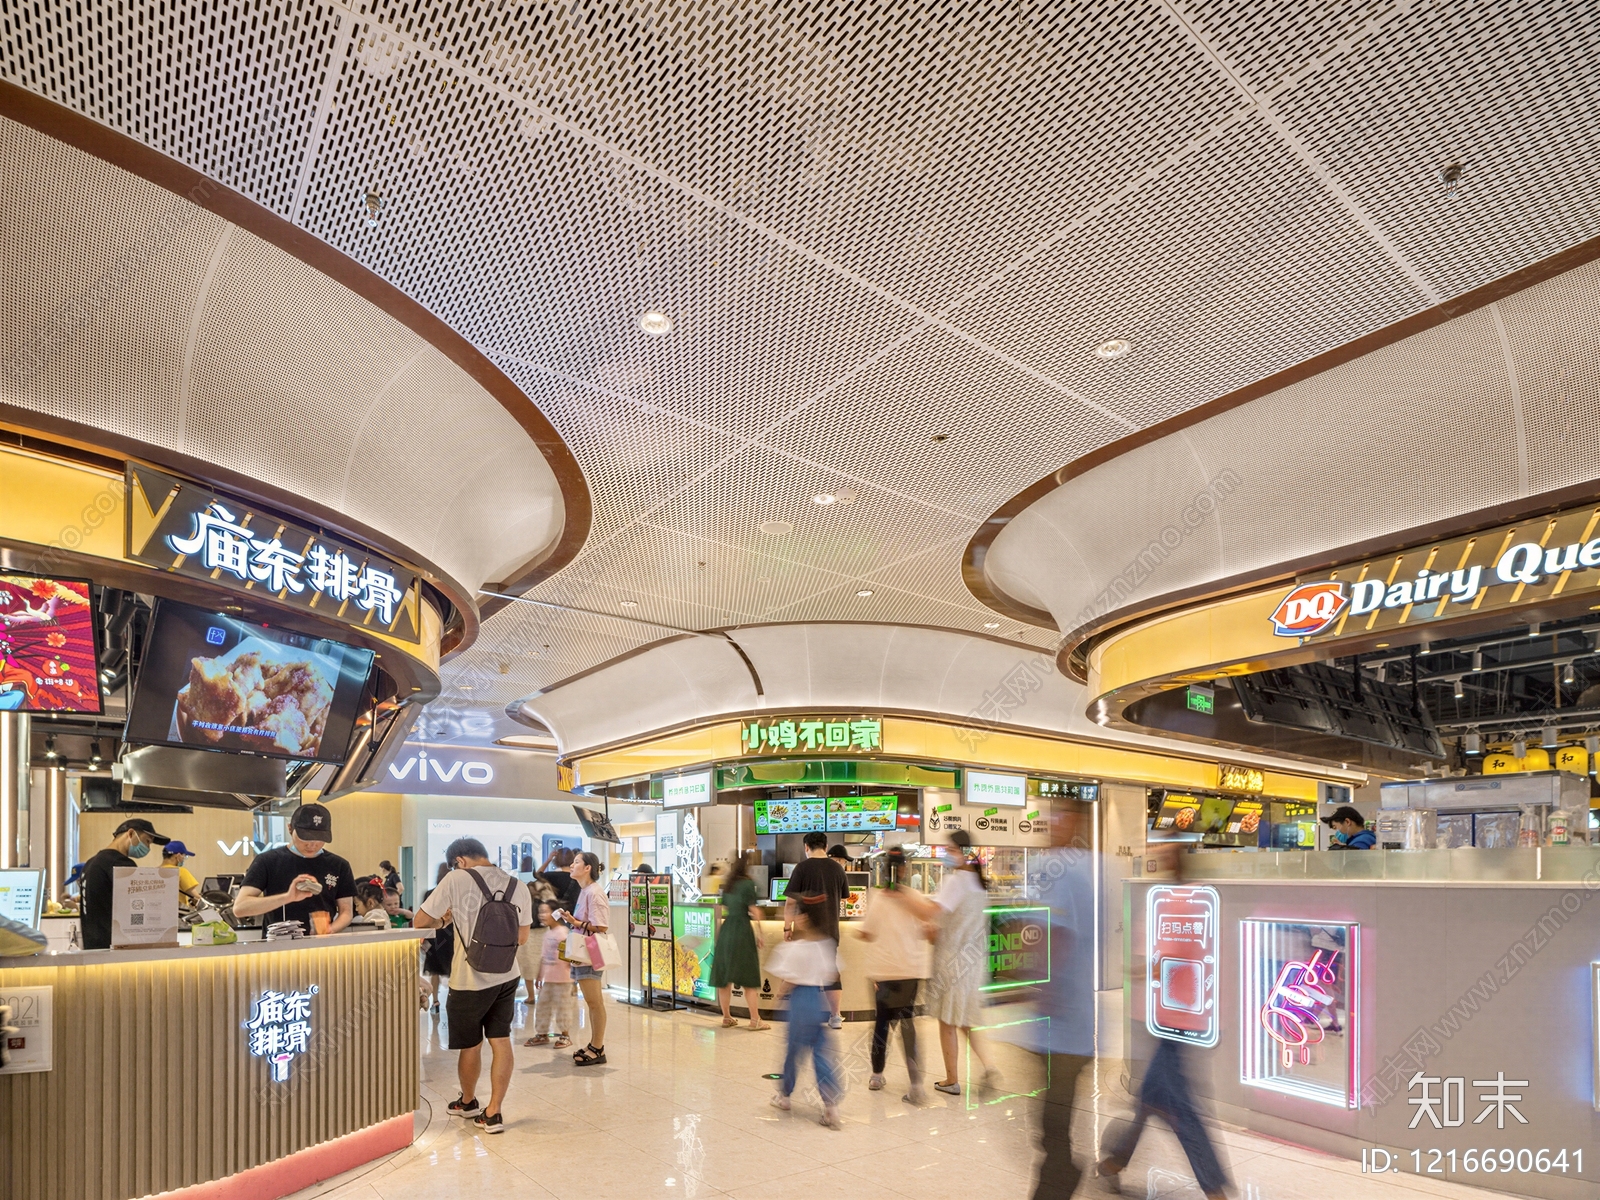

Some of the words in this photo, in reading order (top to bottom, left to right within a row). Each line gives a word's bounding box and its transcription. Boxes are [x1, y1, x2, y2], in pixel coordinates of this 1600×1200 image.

[167, 504, 402, 624] 庙东排骨
[1284, 592, 1331, 625] DQ
[1349, 565, 1481, 616] Dairy
[741, 720, 881, 750] 小鸡不回家
[388, 750, 494, 784] vivo
[1492, 759, 1505, 770] 和
[1561, 753, 1574, 764] 和
[217, 836, 289, 856] viv
[984, 932, 1023, 952] ONO
[245, 989, 312, 1029] 庙东
[249, 1021, 312, 1057] 排骨
